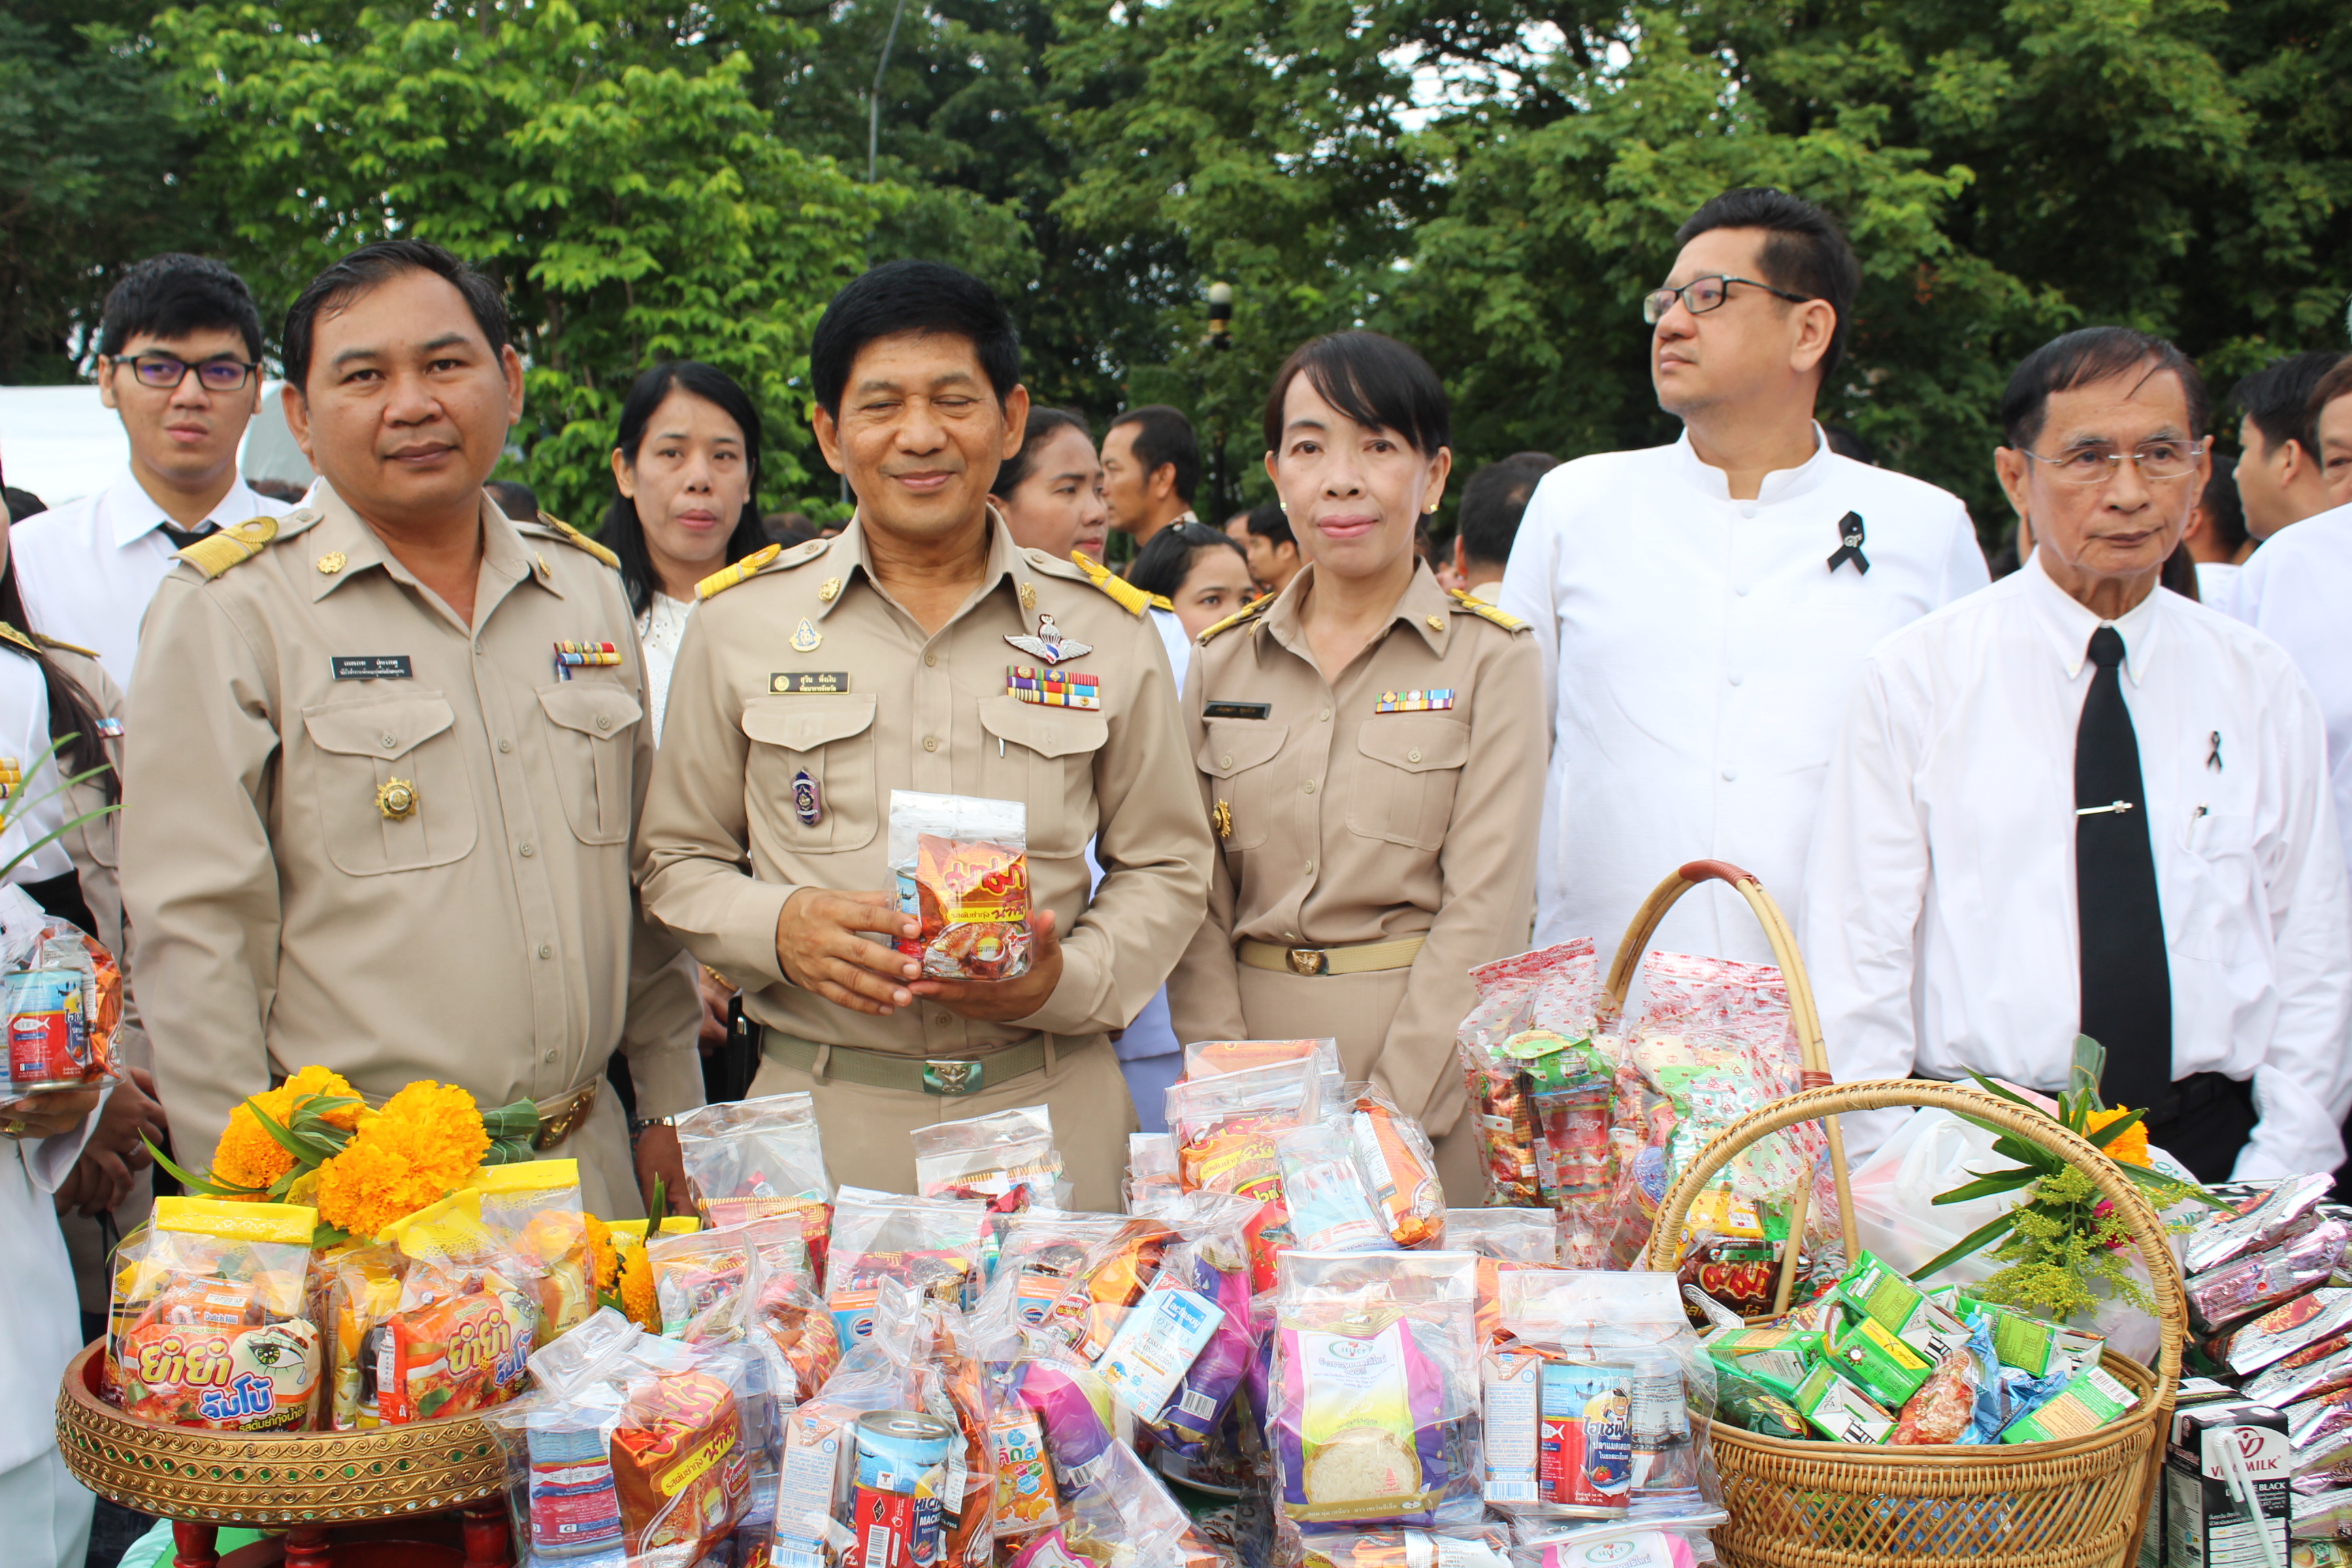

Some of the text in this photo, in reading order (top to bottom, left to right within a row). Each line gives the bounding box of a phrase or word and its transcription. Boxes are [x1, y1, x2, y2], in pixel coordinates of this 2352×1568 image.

[204, 1312, 238, 1324] Dutch Mill
[1160, 1293, 1202, 1328] Lactasoy
[139, 1338, 232, 1385] ยำยำ
[2211, 1458, 2278, 1477] VIMILK
[2259, 1482, 2286, 1491] BLACK
